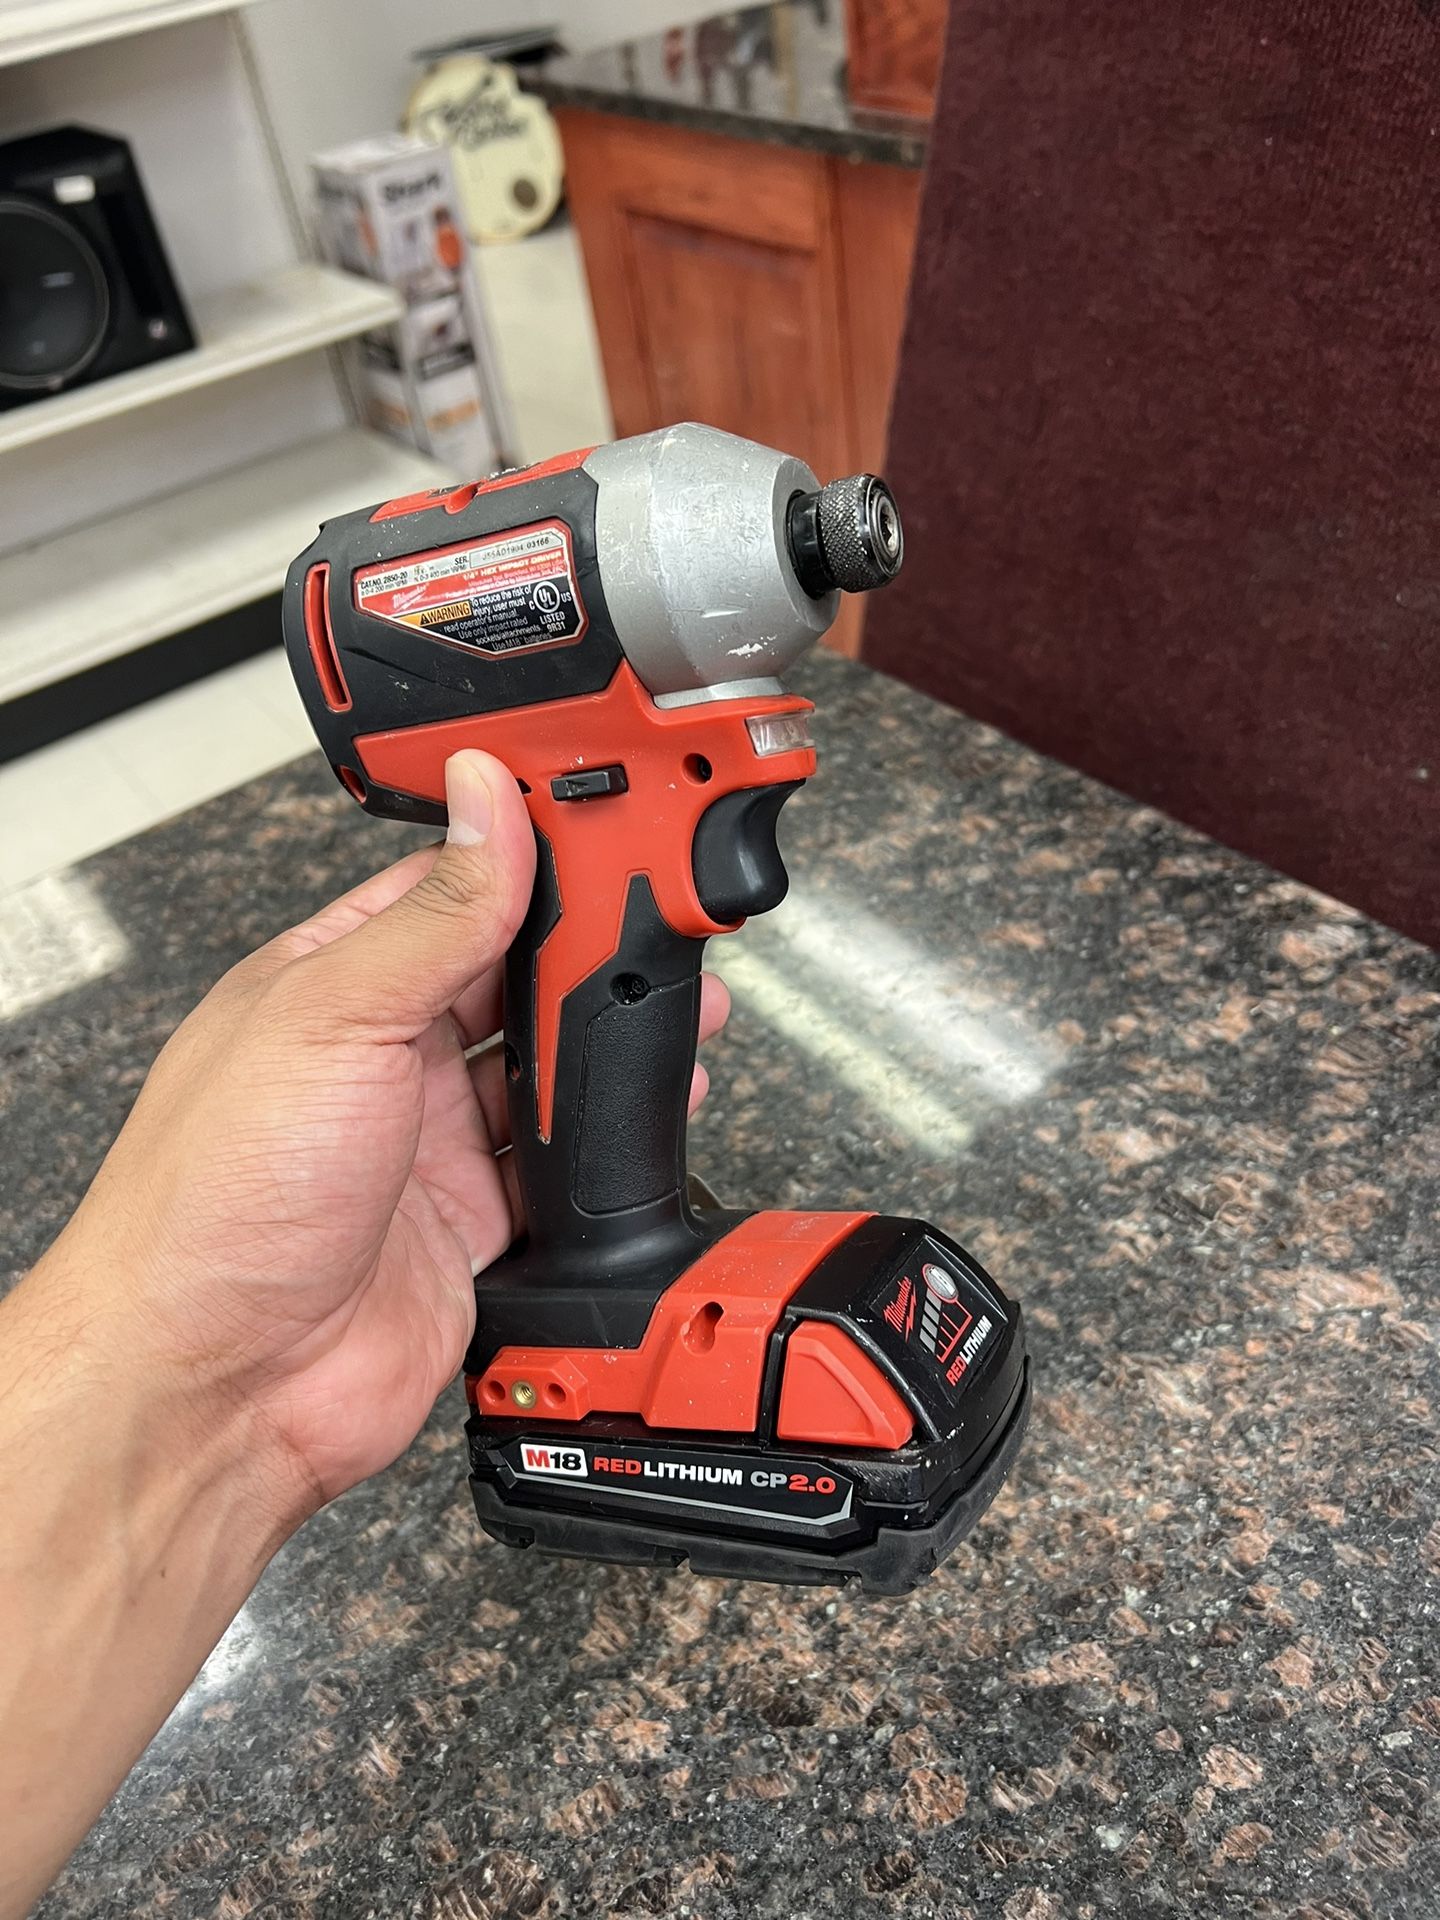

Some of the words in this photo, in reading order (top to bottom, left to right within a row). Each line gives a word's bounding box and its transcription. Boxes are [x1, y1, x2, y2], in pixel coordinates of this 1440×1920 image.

[480, 566, 498, 577] HEX
[499, 560, 530, 571] IMPACT
[531, 552, 562, 564] DRIVER
[383, 572, 408, 584] 2850-20
[471, 598, 479, 607] To
[480, 593, 501, 605] reduce
[501, 591, 512, 600] the
[512, 587, 525, 597] risk
[524, 585, 532, 595] of
[493, 602, 508, 612] user
[508, 598, 526, 608] must
[538, 589, 555, 606] UL
[561, 593, 572, 602] US
[428, 603, 470, 624] WARNING
[539, 612, 566, 625] LISTED
[444, 622, 460, 633] read
[460, 615, 492, 630] operator's
[458, 631, 472, 639] Use
[473, 627, 487, 638] only
[510, 617, 528, 628] rated
[546, 622, 566, 632] 9R31
[492, 642, 506, 650] Use
[945, 1315, 993, 1386] REDLITHIUM
[525, 1448, 582, 1471] M18
[593, 1456, 743, 1486] REDLITHIUM
